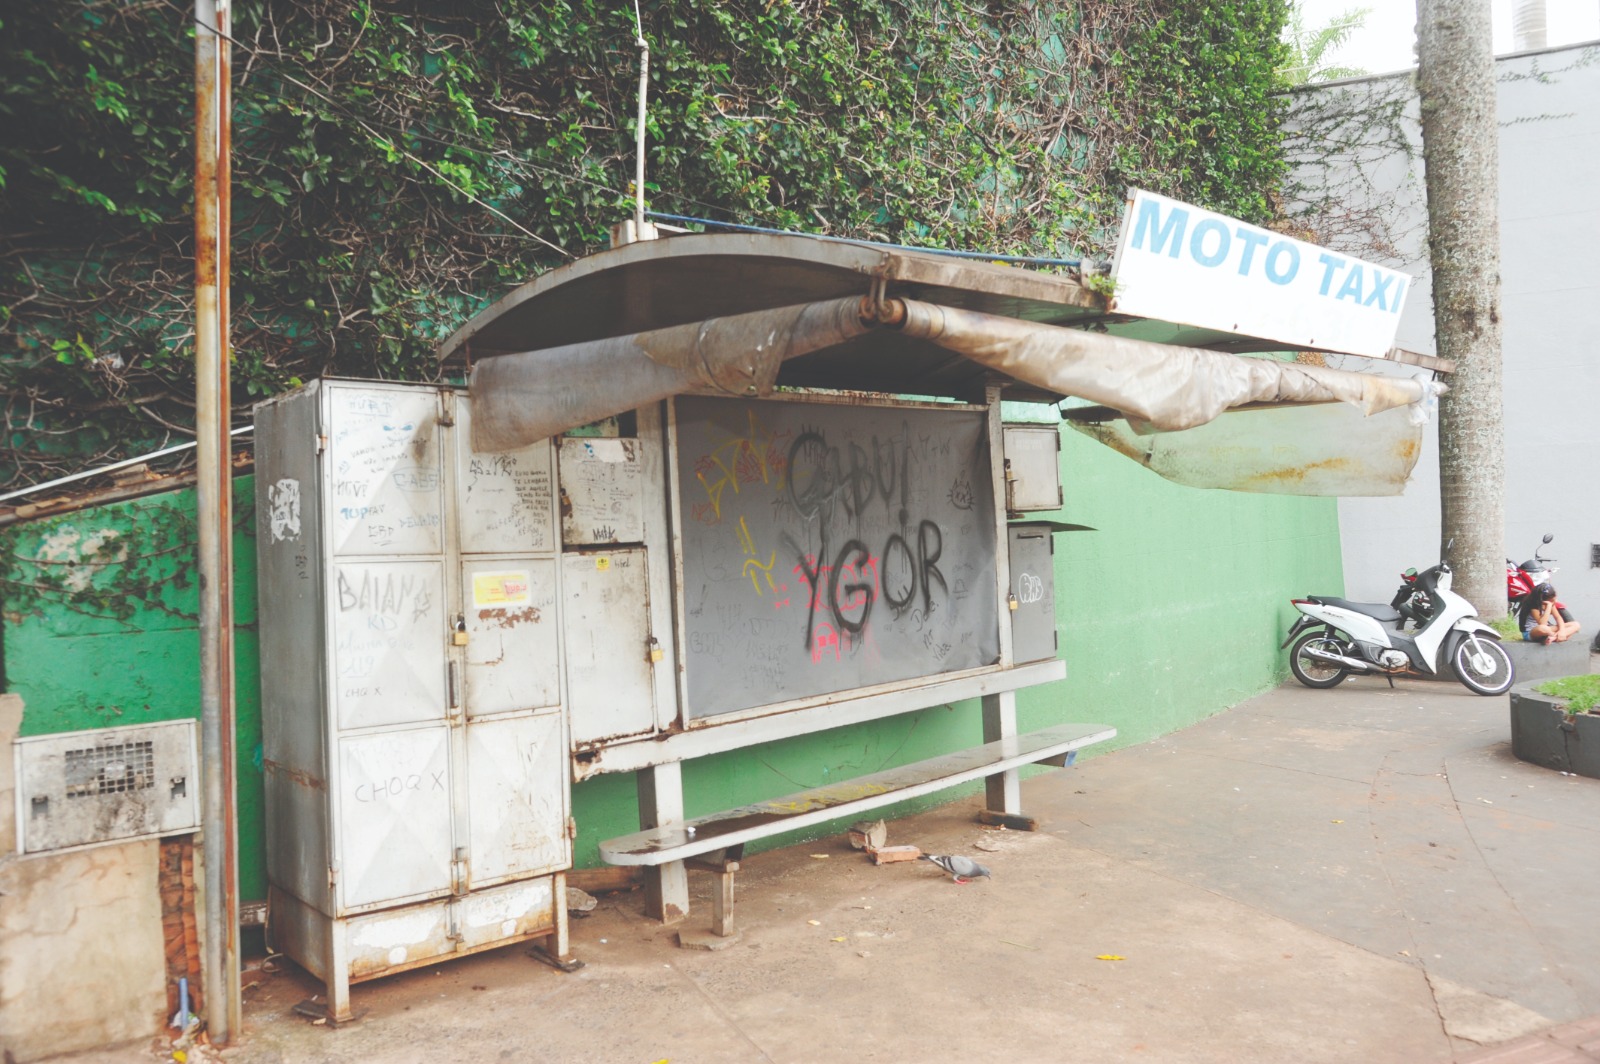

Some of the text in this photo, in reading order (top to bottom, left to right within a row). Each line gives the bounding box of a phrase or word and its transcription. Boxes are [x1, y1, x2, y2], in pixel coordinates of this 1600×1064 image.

[1131, 200, 1406, 314] MOTO TAXI
[354, 770, 445, 803] CHOQ X
